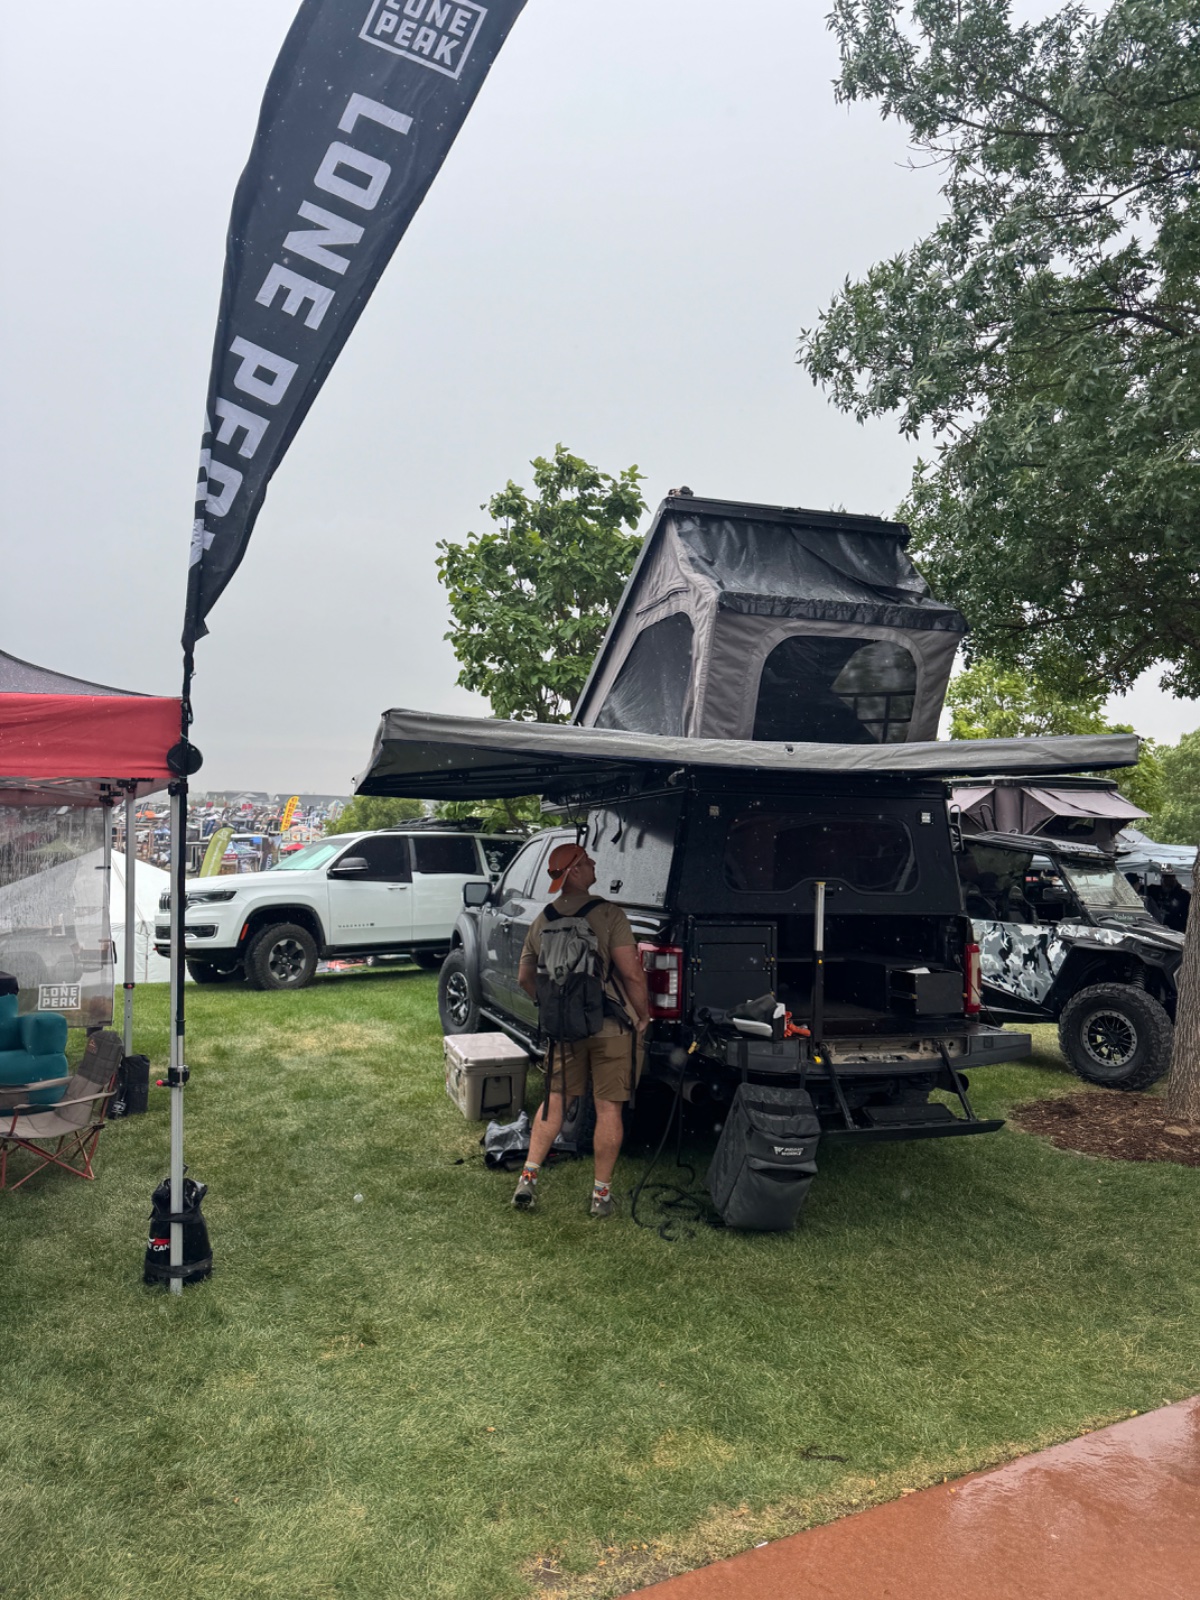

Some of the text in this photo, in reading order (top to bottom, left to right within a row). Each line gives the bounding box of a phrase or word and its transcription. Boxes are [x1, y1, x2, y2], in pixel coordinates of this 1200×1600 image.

[374, 10, 460, 66] PEAK
[255, 92, 414, 331] LONE
[42, 997, 77, 1007] PEAK
[43, 987, 77, 997] LONE
